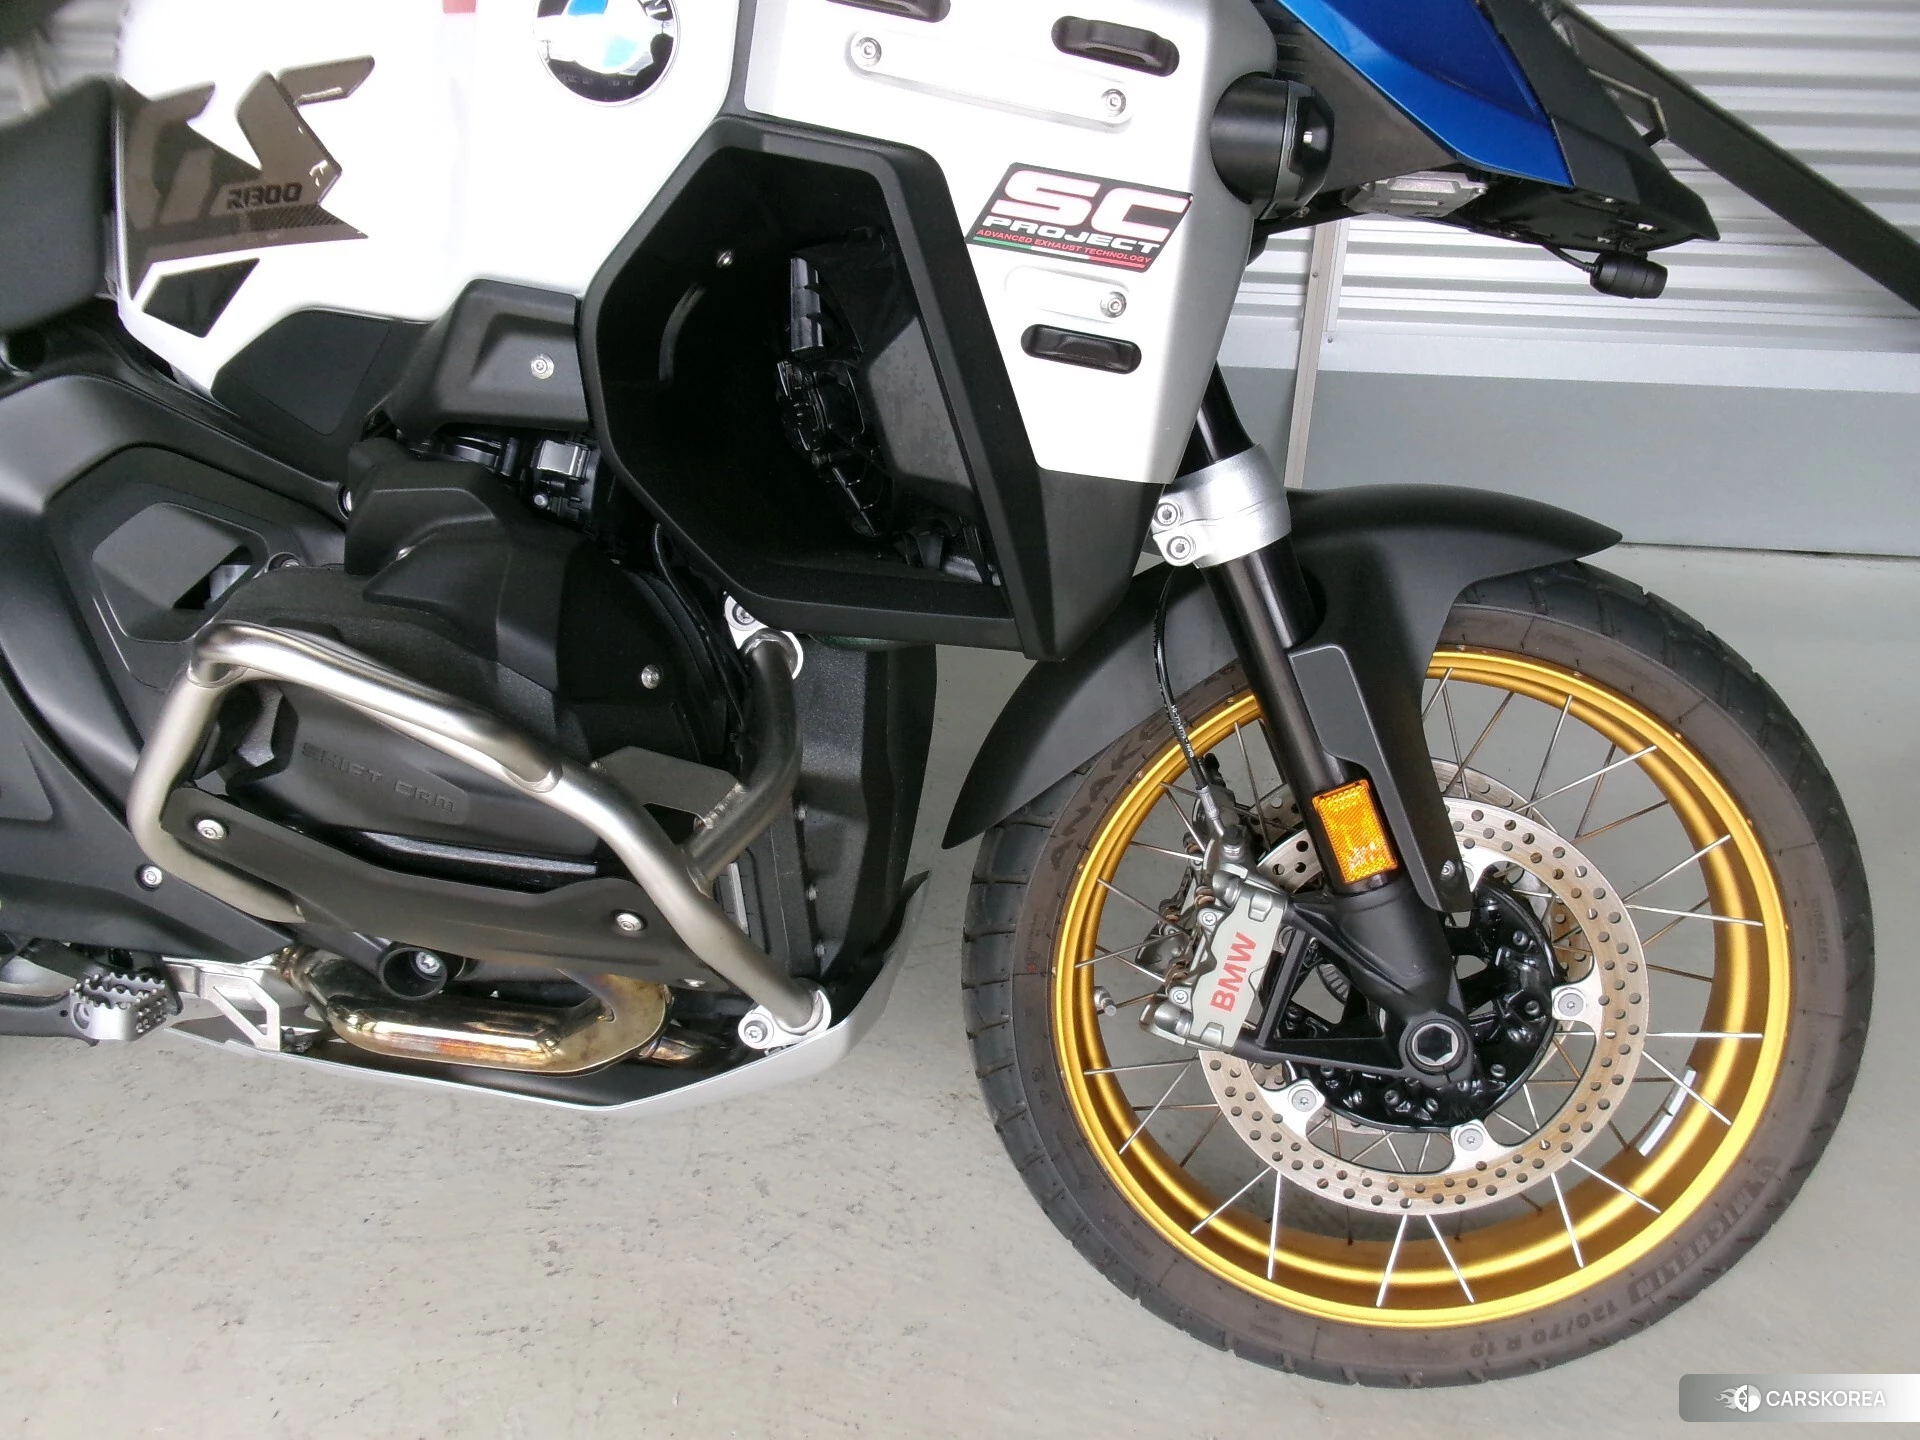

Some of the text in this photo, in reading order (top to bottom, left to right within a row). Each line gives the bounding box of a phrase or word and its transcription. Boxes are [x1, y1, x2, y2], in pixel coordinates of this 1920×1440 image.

[226, 182, 302, 209] R1300
[990, 169, 1190, 243] SC
[976, 229, 1152, 263] ADVANCED EXHAUST TECHNOLOGY
[981, 215, 1161, 254] PROJECT
[1210, 931, 1257, 1012] BMW
[1636, 1187, 1753, 1299] MICHELIN
